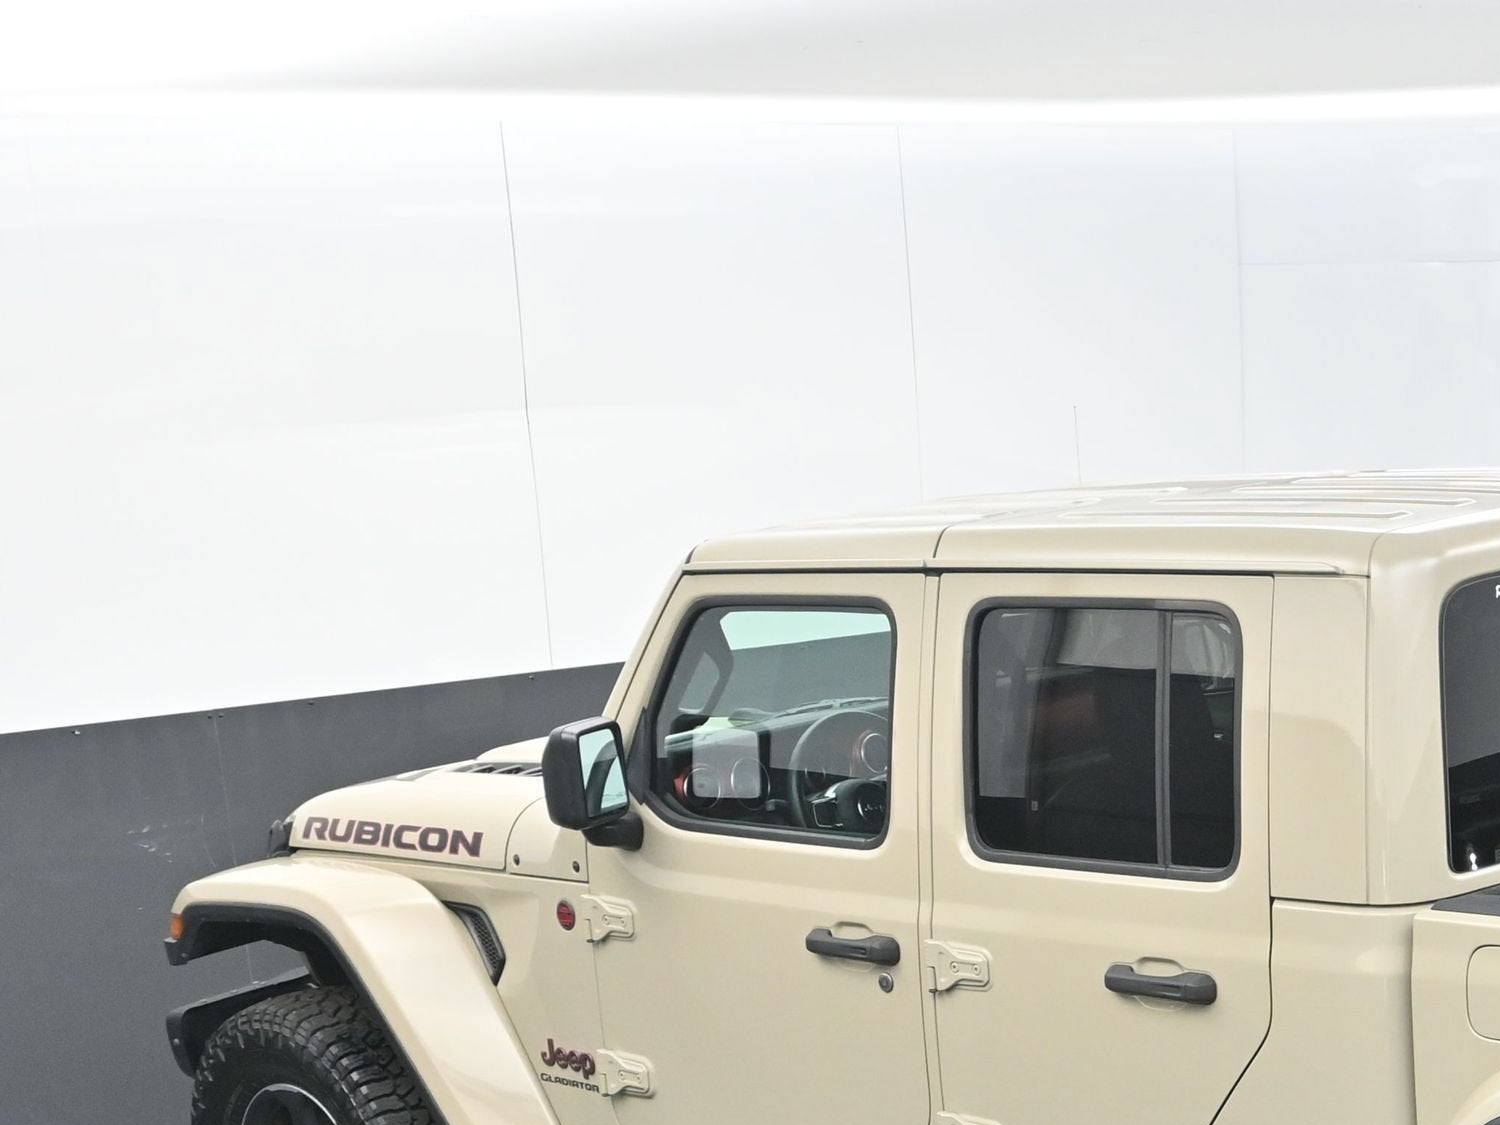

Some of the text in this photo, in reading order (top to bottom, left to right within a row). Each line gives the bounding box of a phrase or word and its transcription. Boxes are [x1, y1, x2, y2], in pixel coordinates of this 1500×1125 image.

[302, 816, 484, 857] RUBICON
[540, 1038, 595, 1080] Jeep
[540, 1072, 601, 1094] GLADIATOR
